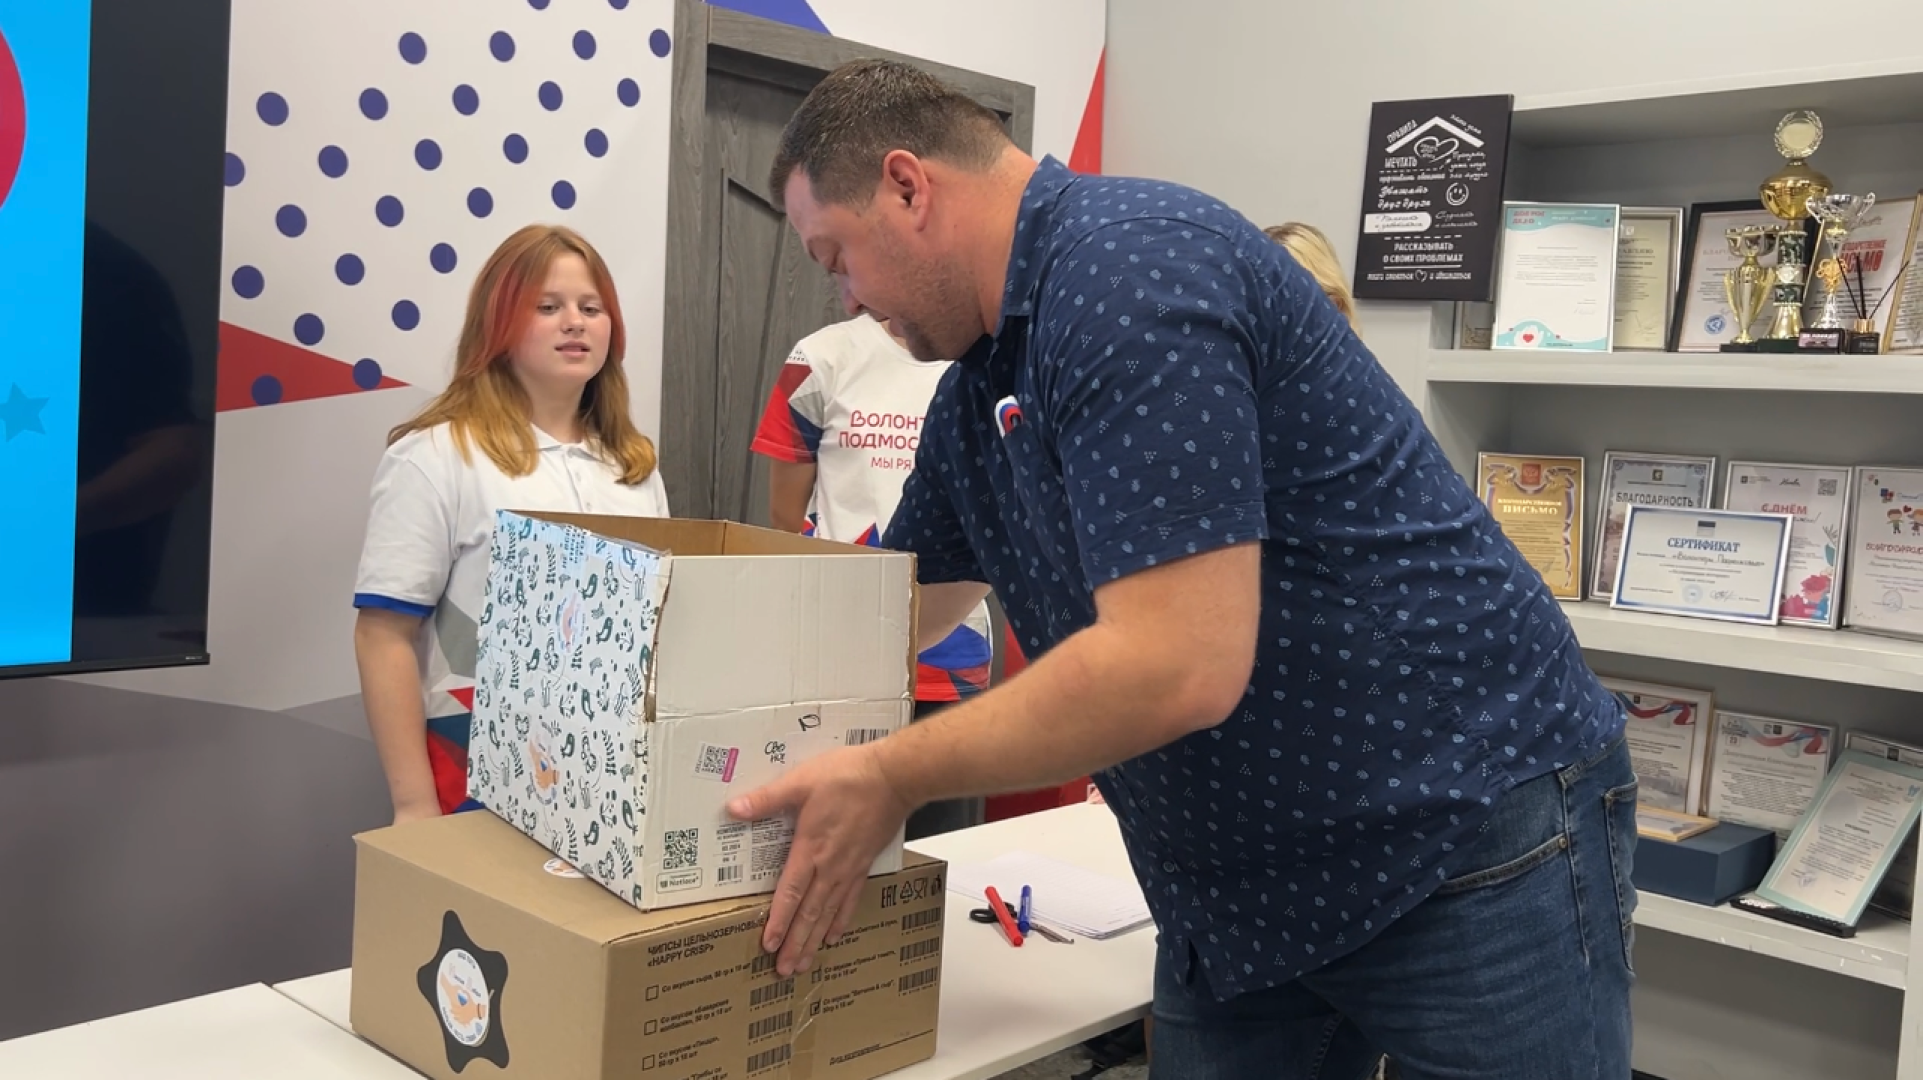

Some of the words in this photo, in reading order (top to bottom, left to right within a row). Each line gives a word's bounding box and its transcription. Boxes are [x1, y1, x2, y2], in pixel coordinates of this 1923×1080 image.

[1384, 156, 1418, 169] МЕЧТАТЬ
[1393, 241, 1454, 251] РАССКАЗЫВАТЬ
[1389, 254, 1415, 263] СВОИХ
[1415, 253, 1464, 263] ПРОБЛЕМАХ
[839, 431, 919, 451] ПОДМОС
[871, 456, 893, 469] МЫ
[896, 457, 914, 471] РЯ
[1616, 492, 1694, 507] БЛАГОДАРНОСТЬ
[1503, 505, 1558, 515] ПИСЬМО
[1761, 503, 1769, 512] С
[1667, 537, 1741, 553] СЕРТИФИКАТ
[648, 938, 682, 955] ЧИПСЫ
[683, 917, 765, 947] ЦЕЛЬНОЗЕРНОВЫЕ
[647, 951, 682, 967] «HAPPY
[684, 943, 714, 958] CRISP»
[823, 998, 831, 1006] Со
[660, 1015, 670, 1024] Со
[671, 1010, 693, 1021] вкусом
[659, 1051, 668, 1059] Со
[669, 1045, 691, 1056] вкусом
